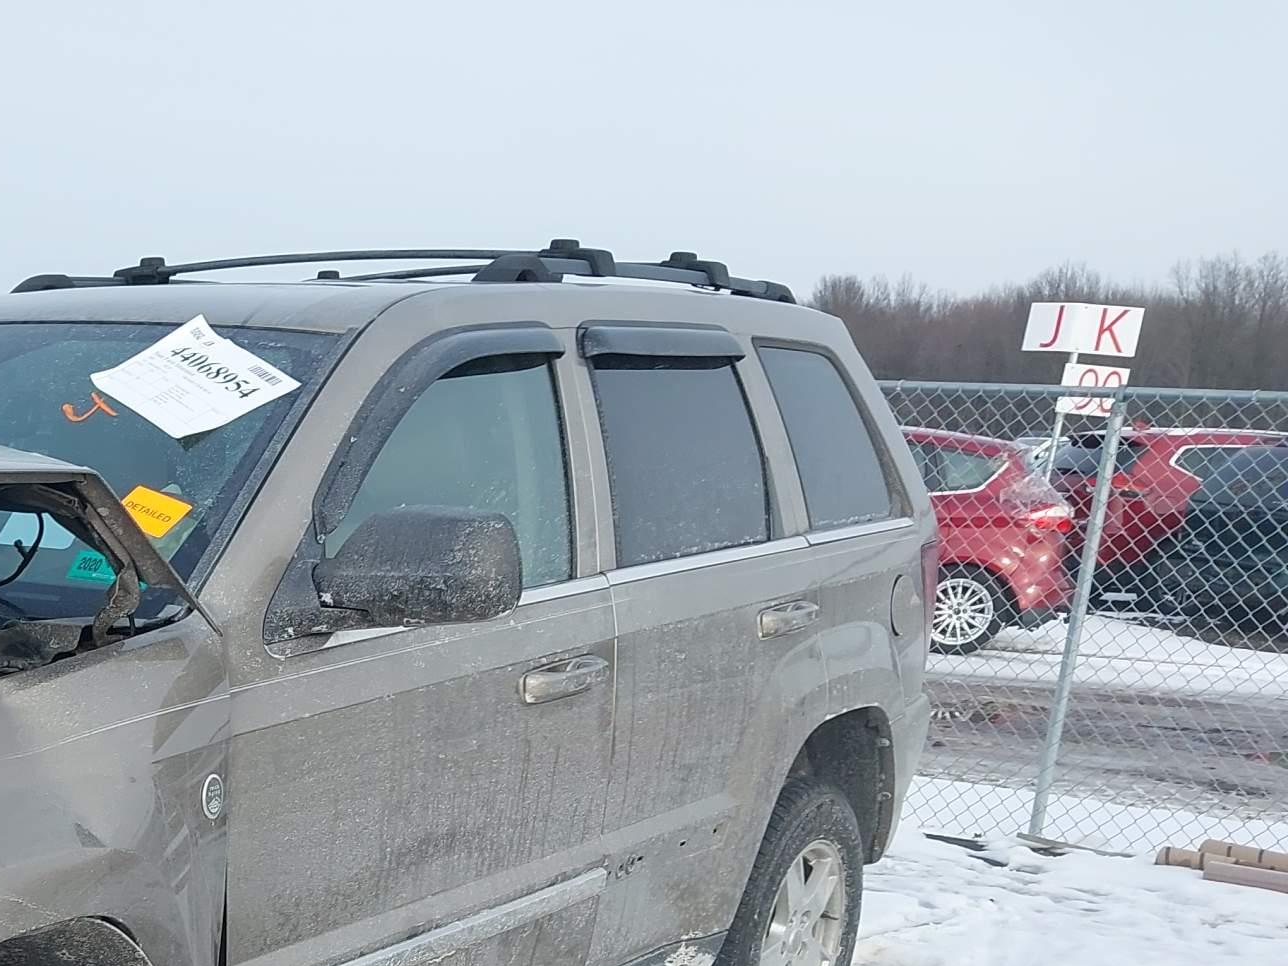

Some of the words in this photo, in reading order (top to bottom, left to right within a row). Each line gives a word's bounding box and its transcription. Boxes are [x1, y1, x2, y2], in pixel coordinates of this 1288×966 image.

[1039, 305, 1065, 348] J
[1094, 308, 1130, 353] K
[169, 346, 261, 399] 44068954
[125, 500, 172, 524] DETAILED
[77, 556, 104, 572] 2020
